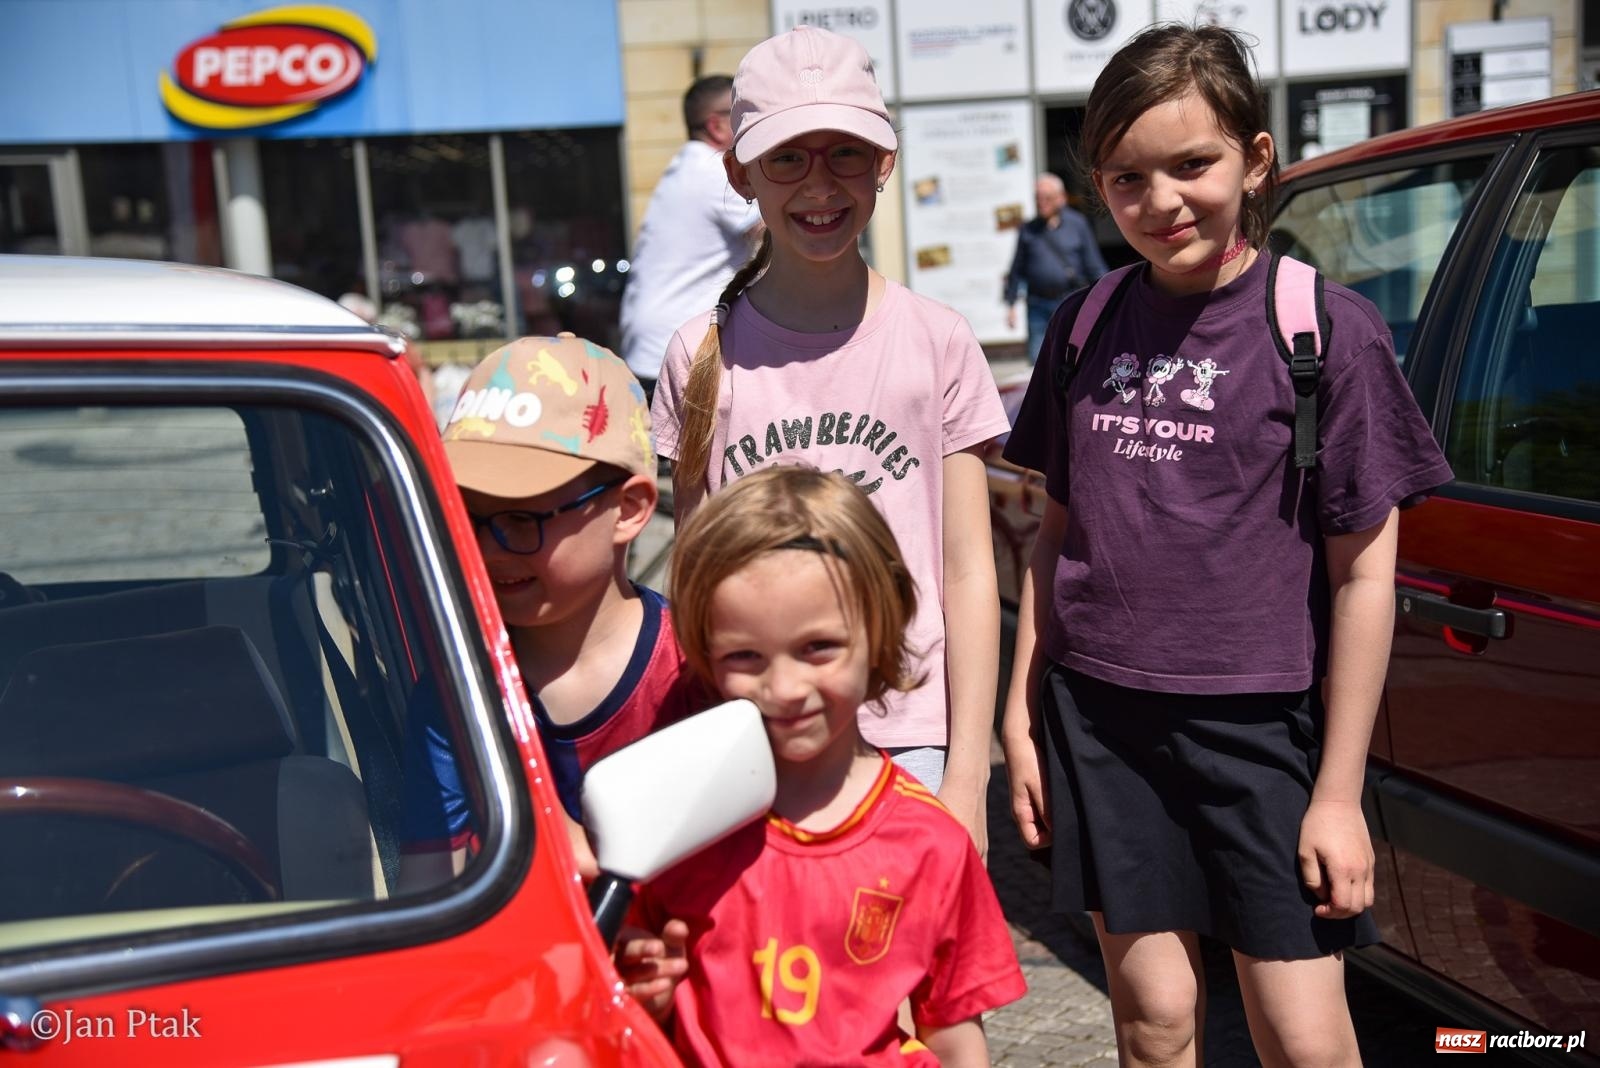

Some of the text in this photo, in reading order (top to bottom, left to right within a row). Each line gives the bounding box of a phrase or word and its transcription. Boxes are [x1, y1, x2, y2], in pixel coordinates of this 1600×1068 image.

[1298, 1, 1388, 35] LODY
[193, 42, 345, 88] PEPCO
[450, 386, 541, 427] DINO
[1091, 413, 1215, 443] IT'S YOUR
[720, 411, 920, 488] TRAWBERRIES
[1113, 438, 1183, 462] Lifestyle
[752, 937, 822, 1026] 19
